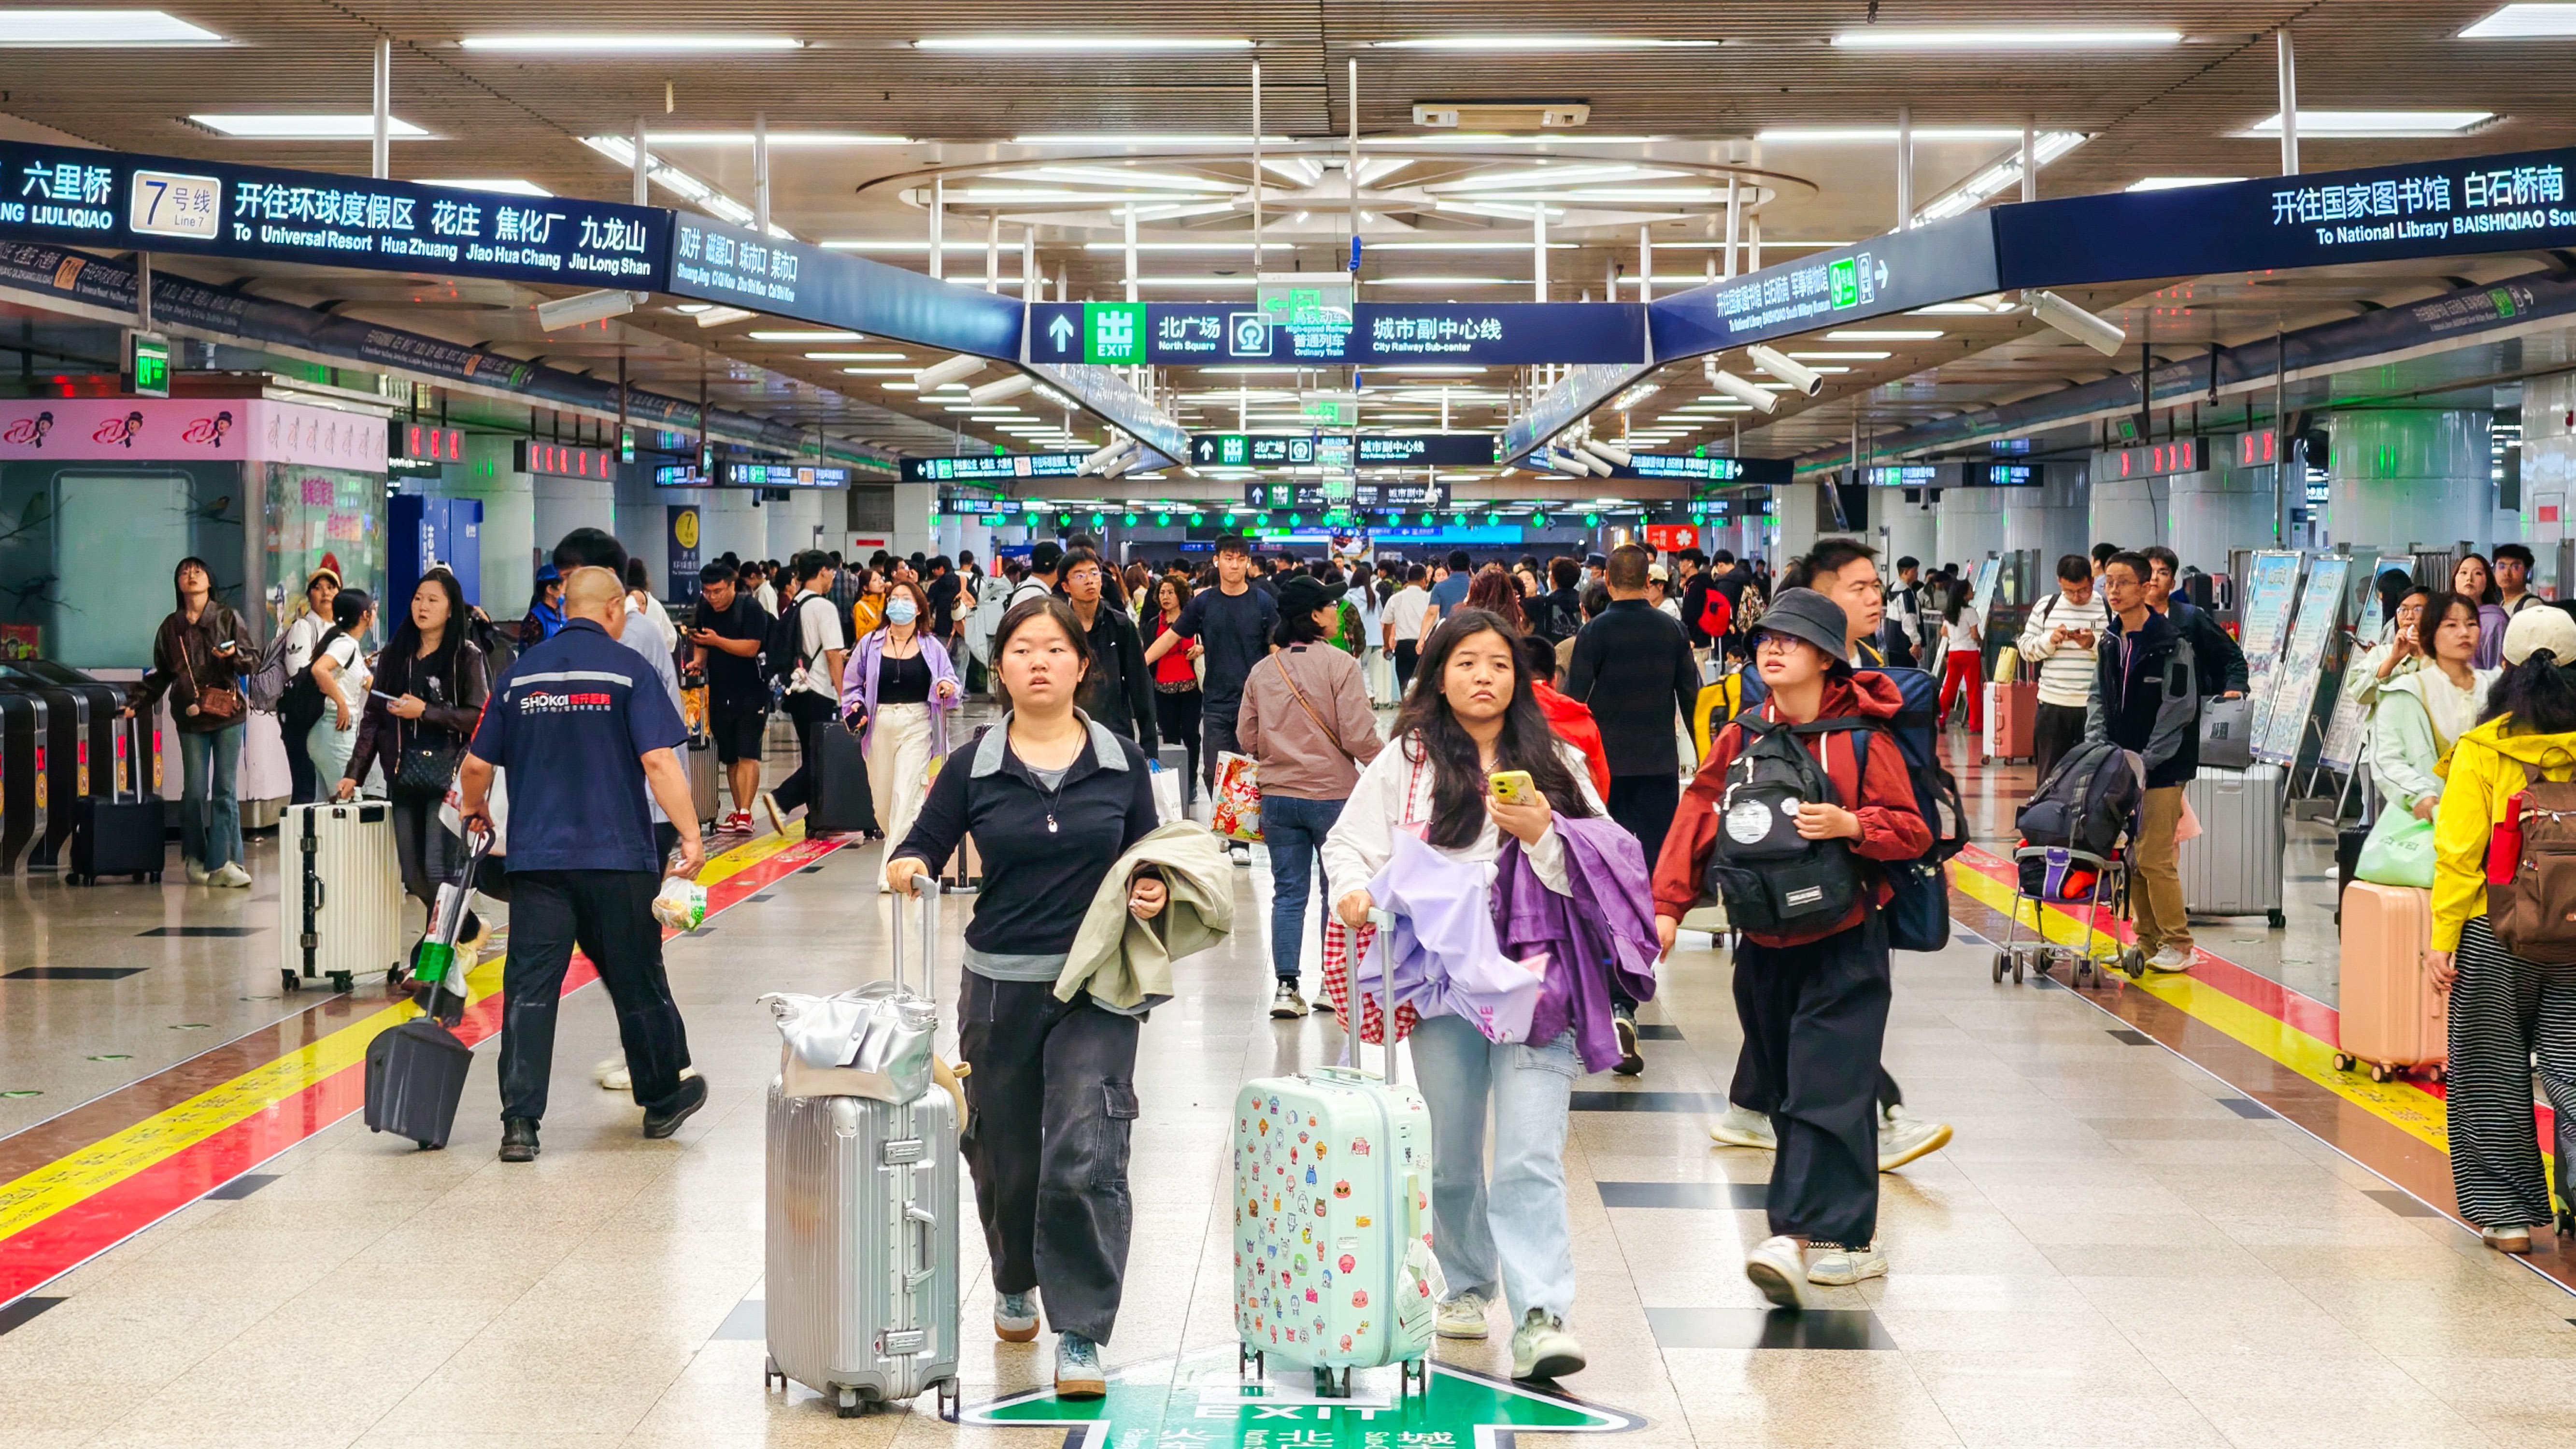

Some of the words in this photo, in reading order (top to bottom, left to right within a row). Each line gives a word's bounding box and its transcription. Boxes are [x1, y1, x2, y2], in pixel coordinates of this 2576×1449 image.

[22, 160, 112, 205] 六里桥
[2272, 175, 2450, 225] 开往国家图书馆
[2464, 164, 2563, 209] 白石桥南
[32, 205, 112, 229] LIULIQIAO
[175, 215, 195, 226] Line
[199, 216, 204, 227] 7
[235, 183, 416, 230] 开往环球度假区
[432, 199, 481, 236] 花庄
[495, 206, 566, 243] 焦化厂
[579, 215, 646, 253] 九龙山
[2316, 228, 2333, 244] To
[2337, 223, 2394, 243] National
[2398, 221, 2448, 239] Library
[2453, 210, 2545, 234] BAISHIQIAO
[233, 223, 251, 241] To
[261, 225, 326, 247] Universal
[327, 231, 372, 251] Resort
[381, 236, 408, 254] Hua
[409, 238, 458, 262] Zhuang
[466, 243, 493, 262] Jiao
[495, 246, 520, 264] Hua
[522, 248, 561, 270] Chang
[569, 253, 588, 270] Jiu
[589, 255, 619, 276] Long
[621, 257, 651, 275] Shan
[679, 227, 700, 260] 双井
[705, 232, 734, 267] 磁器口
[739, 241, 767, 275] 珠市口
[770, 249, 797, 282] 菜市口
[1159, 316, 1220, 338] 北广场
[1373, 317, 1502, 340] 城市副中心线
[1159, 341, 1183, 350] North
[1184, 341, 1216, 352] Square
[1294, 334, 1345, 348] 普通列车
[1373, 342, 1390, 353] City
[1392, 342, 1424, 353] Railway
[1425, 342, 1471, 351] Sub-center
[1097, 344, 1132, 356] EXIT
[1295, 349, 1324, 357] Ordinary
[1254, 441, 1286, 453] 北广场
[1361, 440, 1424, 453] 城市副中心线
[686, 513, 692, 530] 7
[1194, 1406, 1392, 1420] EXIT
